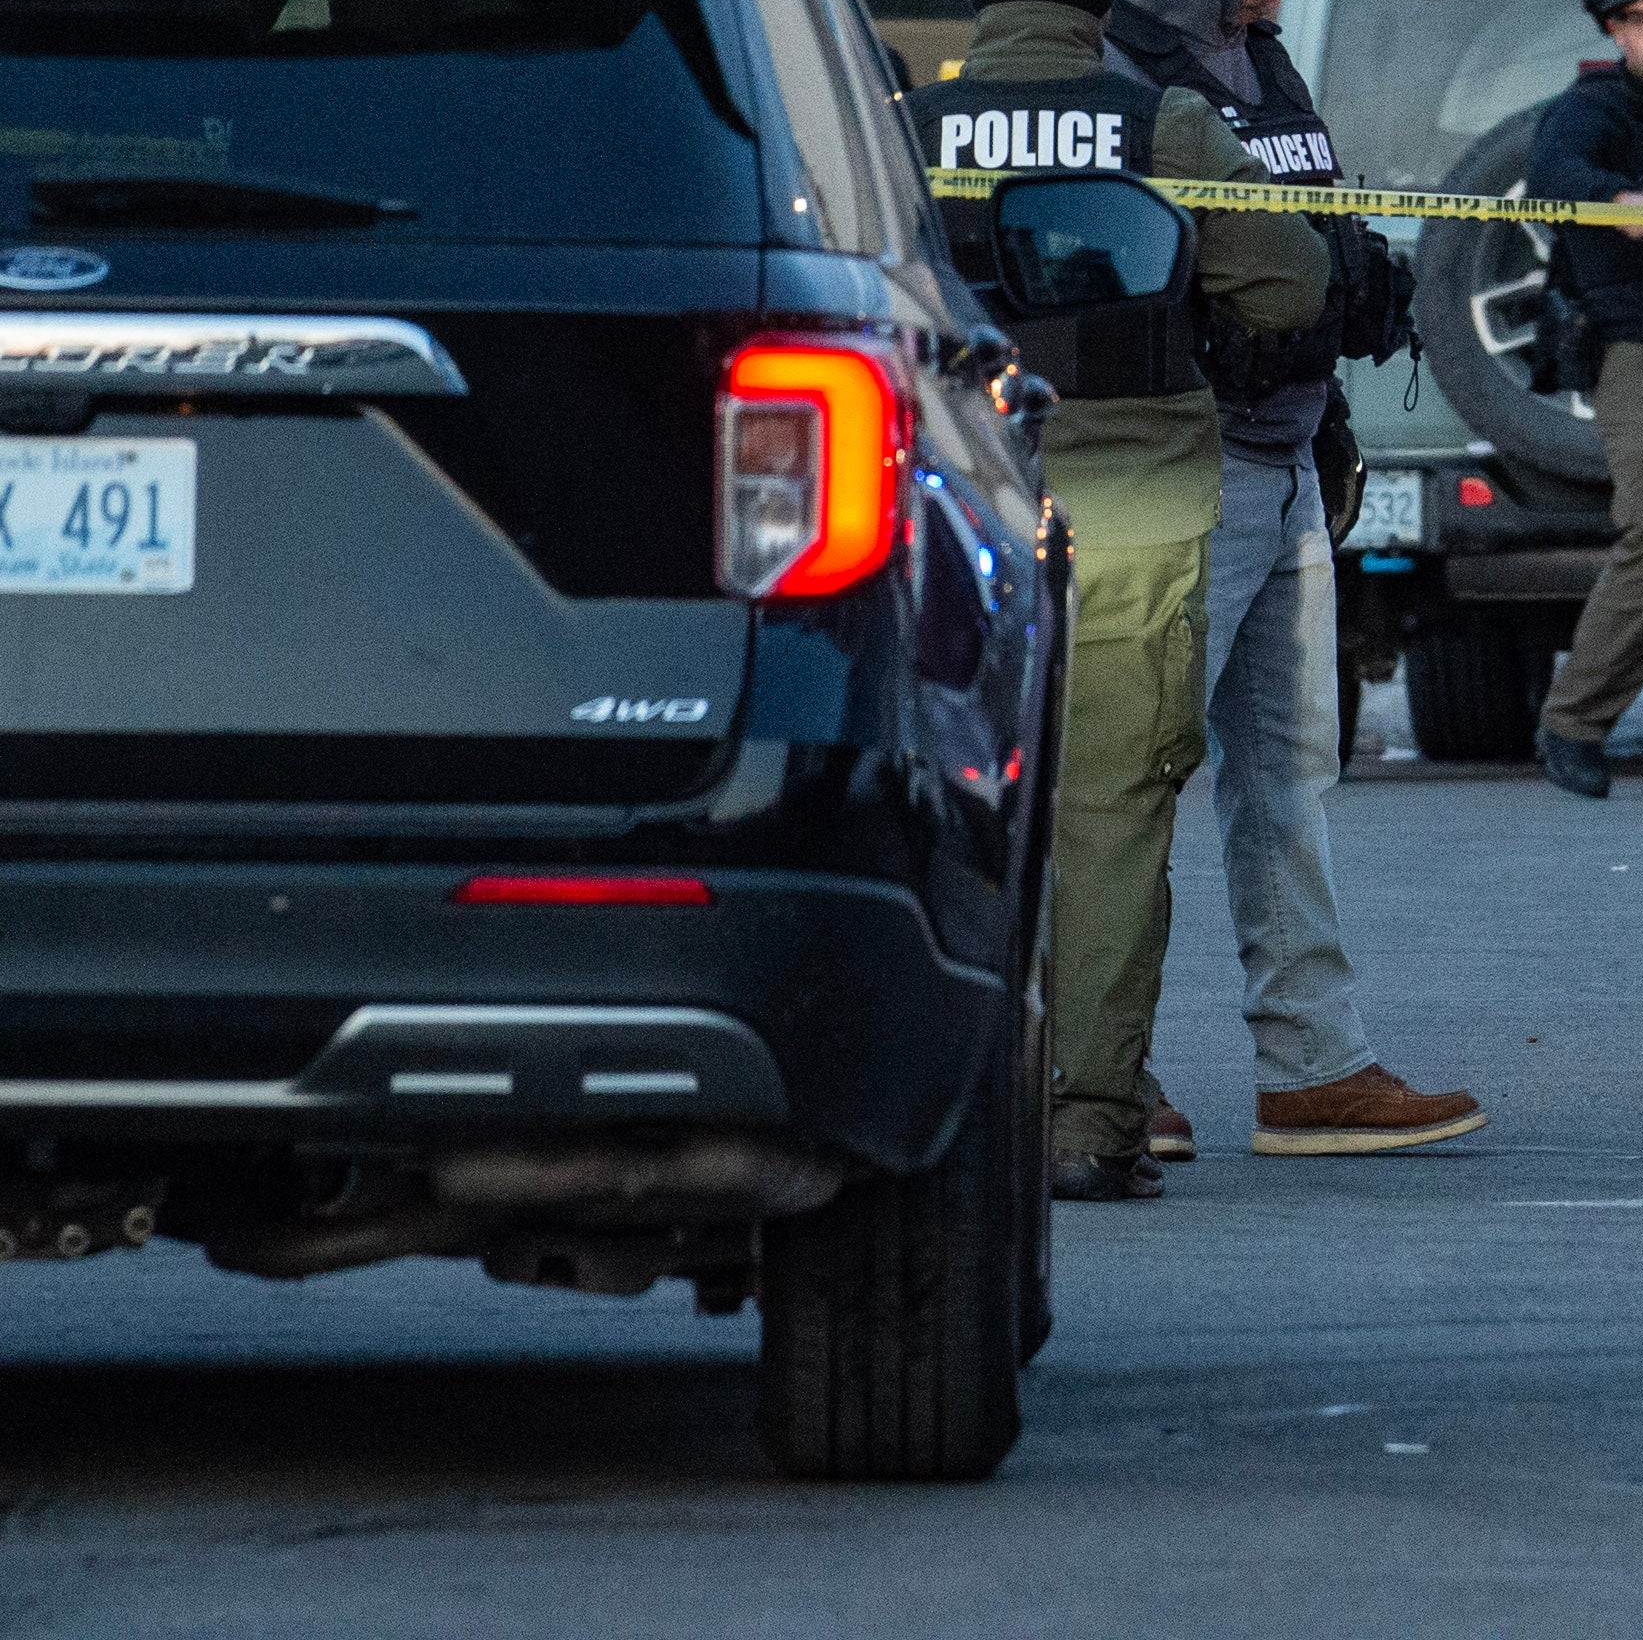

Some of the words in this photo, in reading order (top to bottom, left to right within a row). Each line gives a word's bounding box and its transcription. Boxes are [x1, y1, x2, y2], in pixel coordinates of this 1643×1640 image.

[941, 109, 1123, 171] POLICE
[1241, 134, 1313, 174] OLICE
[1304, 132, 1333, 171] K9
[62, 480, 169, 552] 491
[570, 695, 709, 723] 4WD
